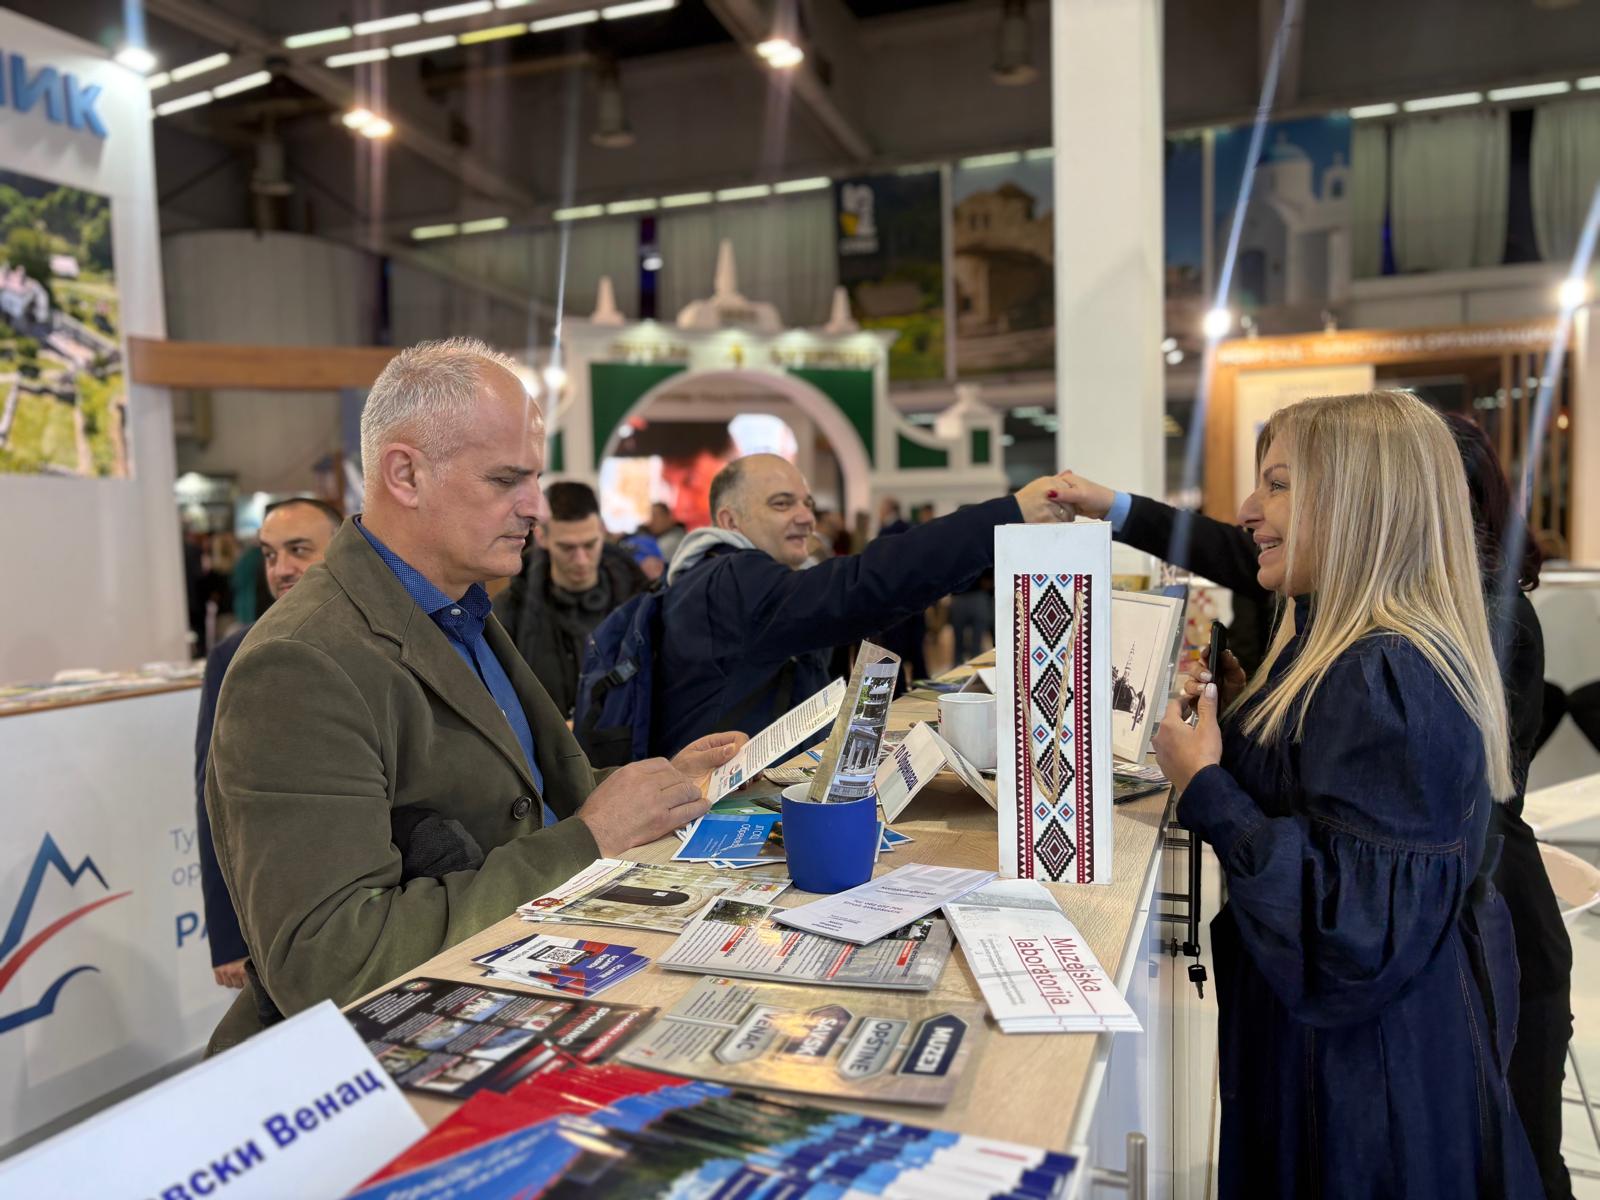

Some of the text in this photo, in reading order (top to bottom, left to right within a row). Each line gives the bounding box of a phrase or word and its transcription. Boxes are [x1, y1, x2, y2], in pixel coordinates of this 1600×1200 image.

[0, 48, 108, 139] ИК
[1014, 938, 1074, 1005] laboratorija
[1049, 937, 1103, 993] Muzejska
[263, 1069, 386, 1148] Венац
